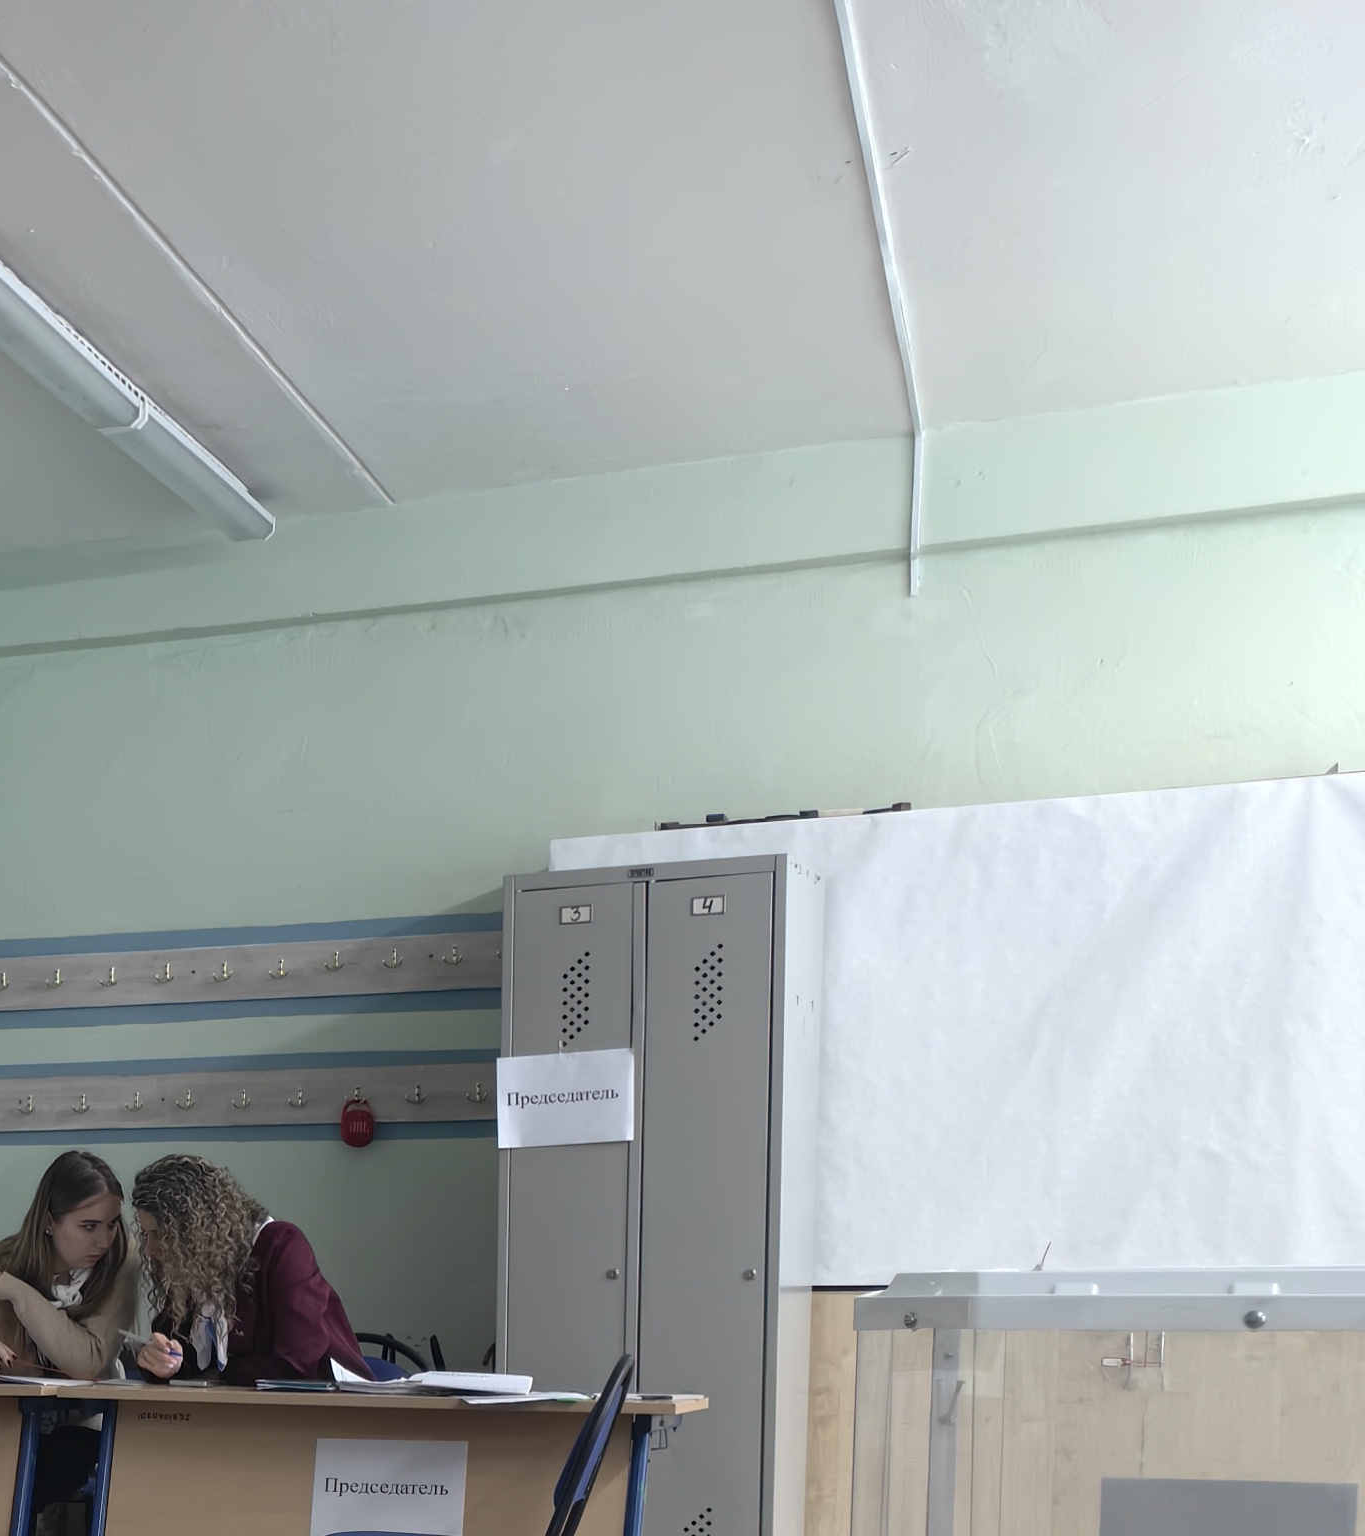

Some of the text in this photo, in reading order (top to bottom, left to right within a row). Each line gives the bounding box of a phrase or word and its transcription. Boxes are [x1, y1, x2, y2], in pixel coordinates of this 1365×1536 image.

[570, 905, 582, 922] 3
[702, 896, 714, 914] 4
[506, 1087, 620, 1109] Председатель
[324, 1476, 449, 1497] Председатель
